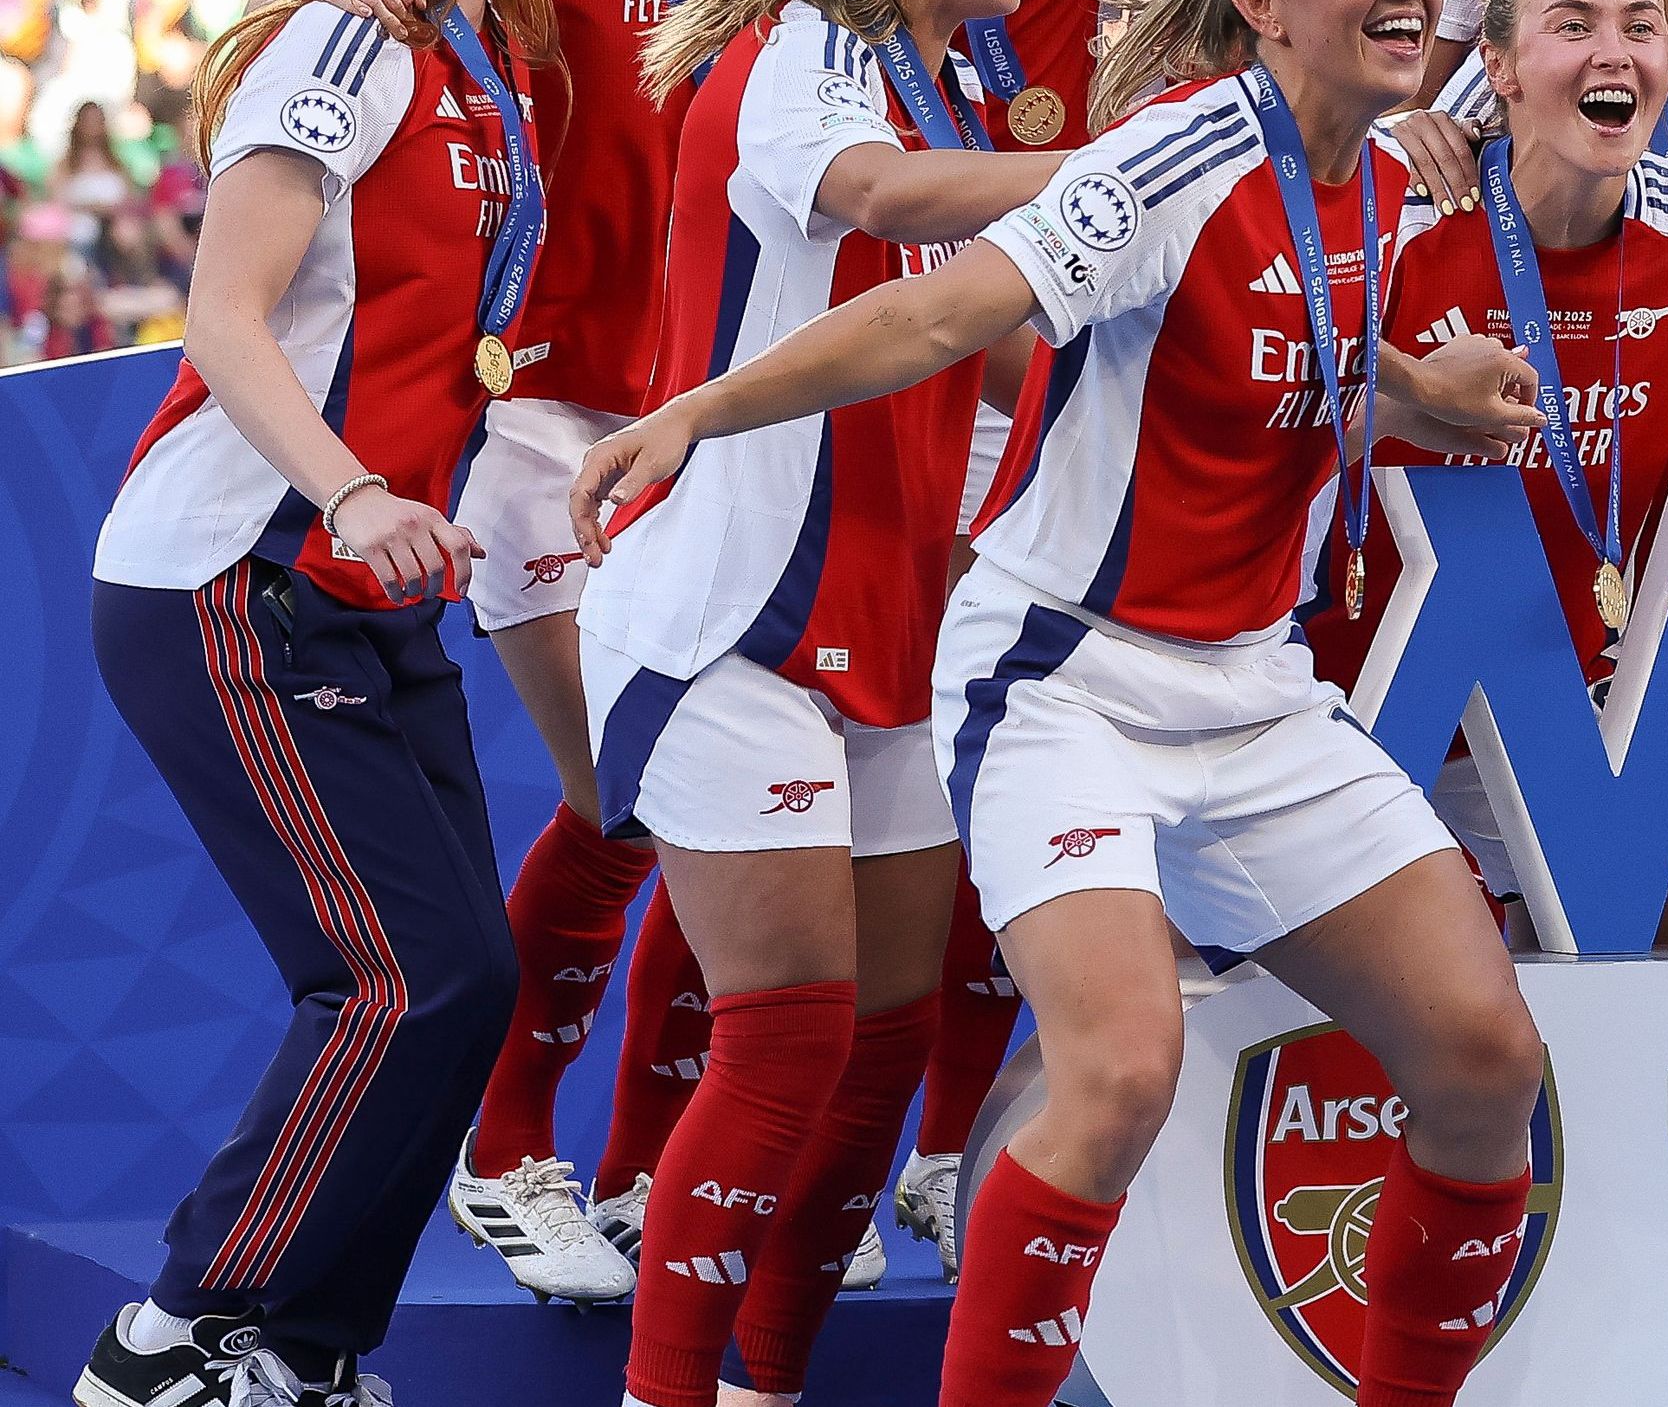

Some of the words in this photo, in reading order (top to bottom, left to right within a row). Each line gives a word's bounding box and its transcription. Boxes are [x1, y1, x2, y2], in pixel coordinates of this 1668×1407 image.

[984, 28, 1010, 76] LISBON
[907, 81, 934, 124] FINAL
[509, 135, 523, 180] LISBON
[1488, 165, 1509, 212] LISBON
[1506, 234, 1526, 276] FINAL
[1301, 227, 1320, 273] FINAL
[496, 279, 519, 326] LISBON
[518, 222, 535, 263] FINAL
[1314, 298, 1329, 349] LISBON
[1565, 311, 1593, 322] 2025
[1266, 390, 1314, 429] FLY
[1562, 379, 1651, 425] ates
[1540, 385, 1564, 431] LISBON
[1560, 451, 1580, 489] FINAL
[1271, 1084, 1410, 1146] Arse
[689, 1179, 776, 1217] AFC
[149, 1376, 175, 1396] CAMPUS
